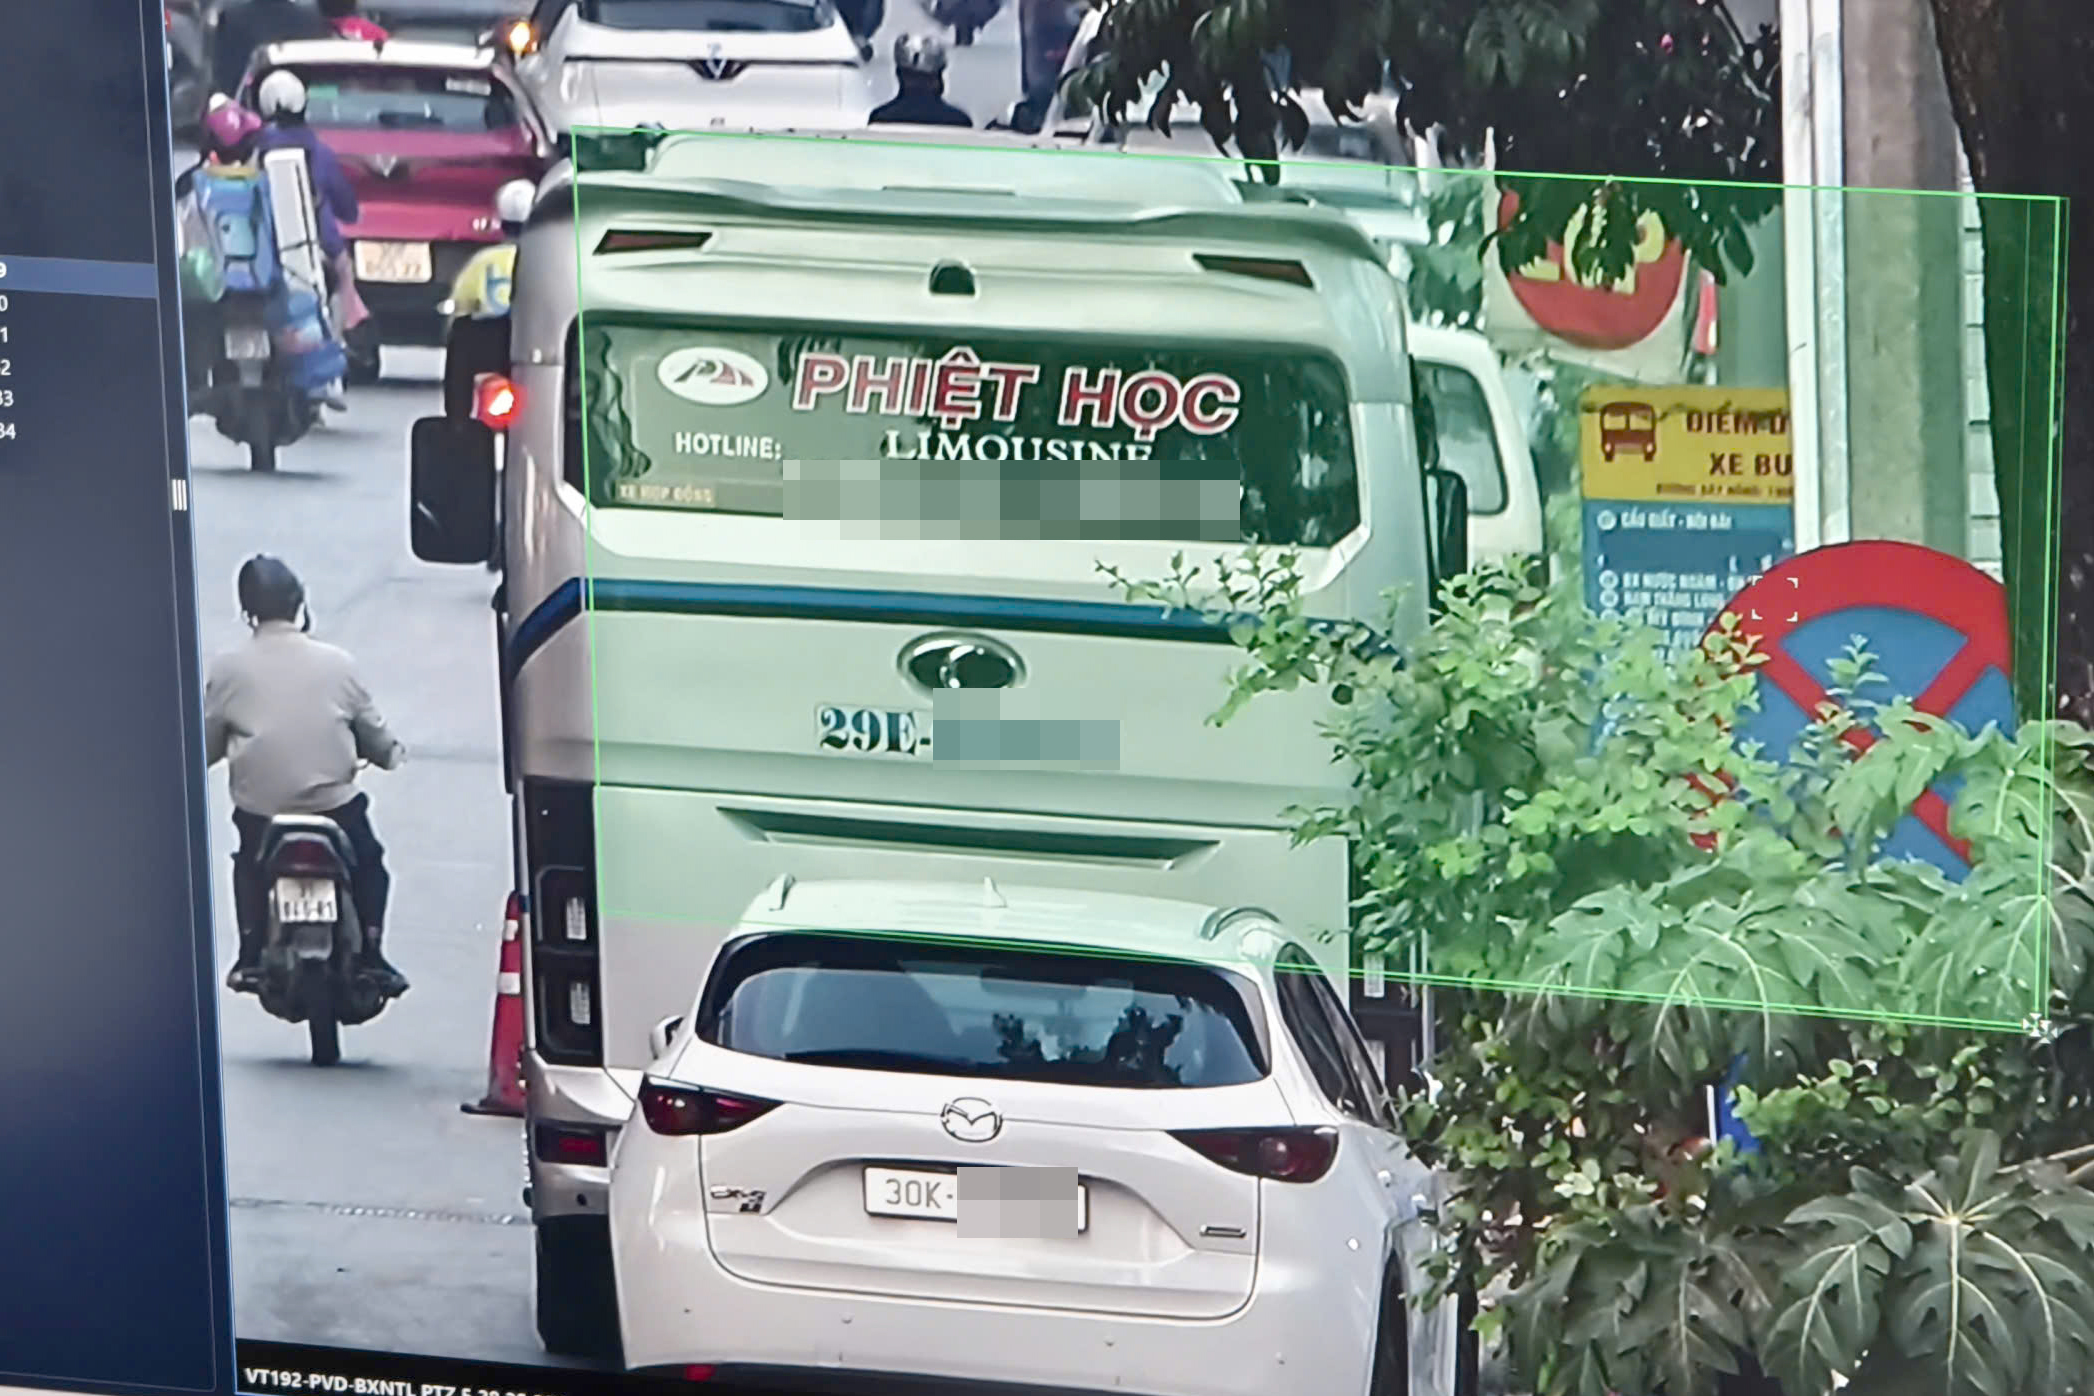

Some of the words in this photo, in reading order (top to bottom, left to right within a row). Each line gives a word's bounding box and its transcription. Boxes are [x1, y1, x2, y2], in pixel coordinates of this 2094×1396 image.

[792, 346, 1040, 430] PHIỆT
[1058, 365, 1241, 441] HỌC
[675, 431, 782, 460] HOTLINE:
[1709, 452, 1743, 475] XE
[1754, 453, 1792, 477] BU
[820, 707, 932, 756] 29E-
[885, 1177, 954, 1210] 30K-
[244, 1367, 416, 1396] VT192-PVD-BXNTL
